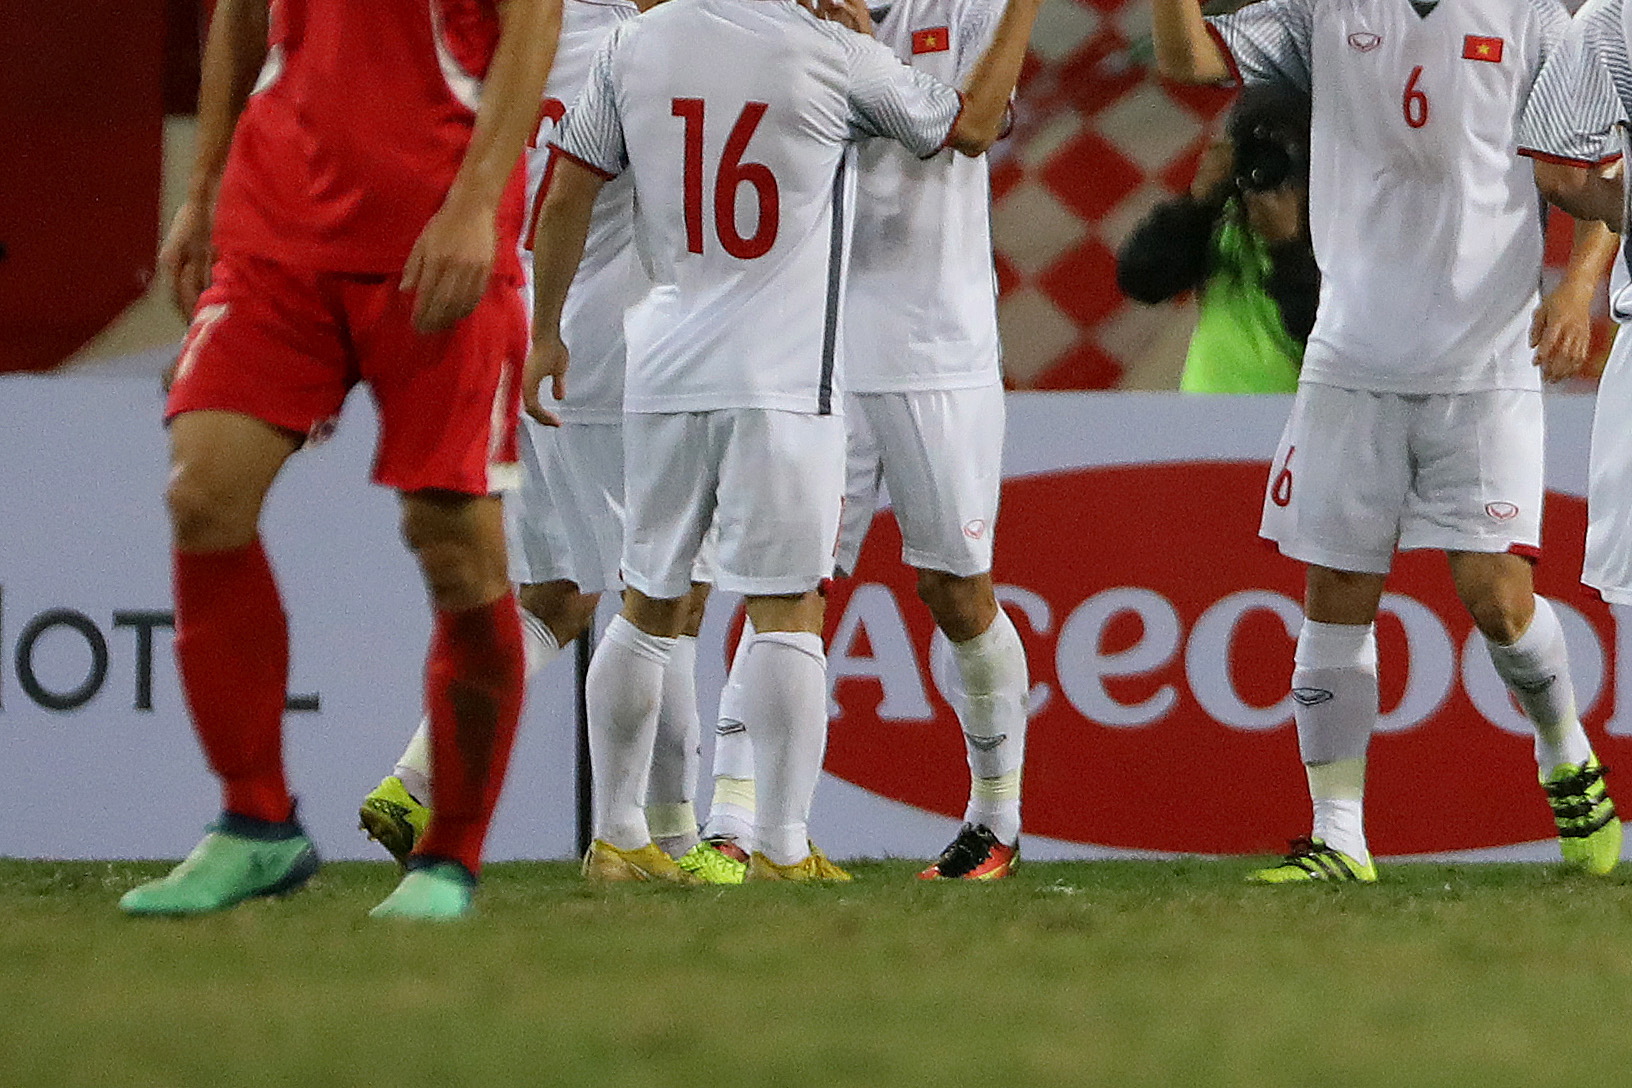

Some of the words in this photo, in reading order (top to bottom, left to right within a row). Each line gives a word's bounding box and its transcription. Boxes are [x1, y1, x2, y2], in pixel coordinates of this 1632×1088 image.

[1403, 65, 1428, 129] 6
[671, 97, 780, 260] 16
[1271, 445, 1295, 508] 6
